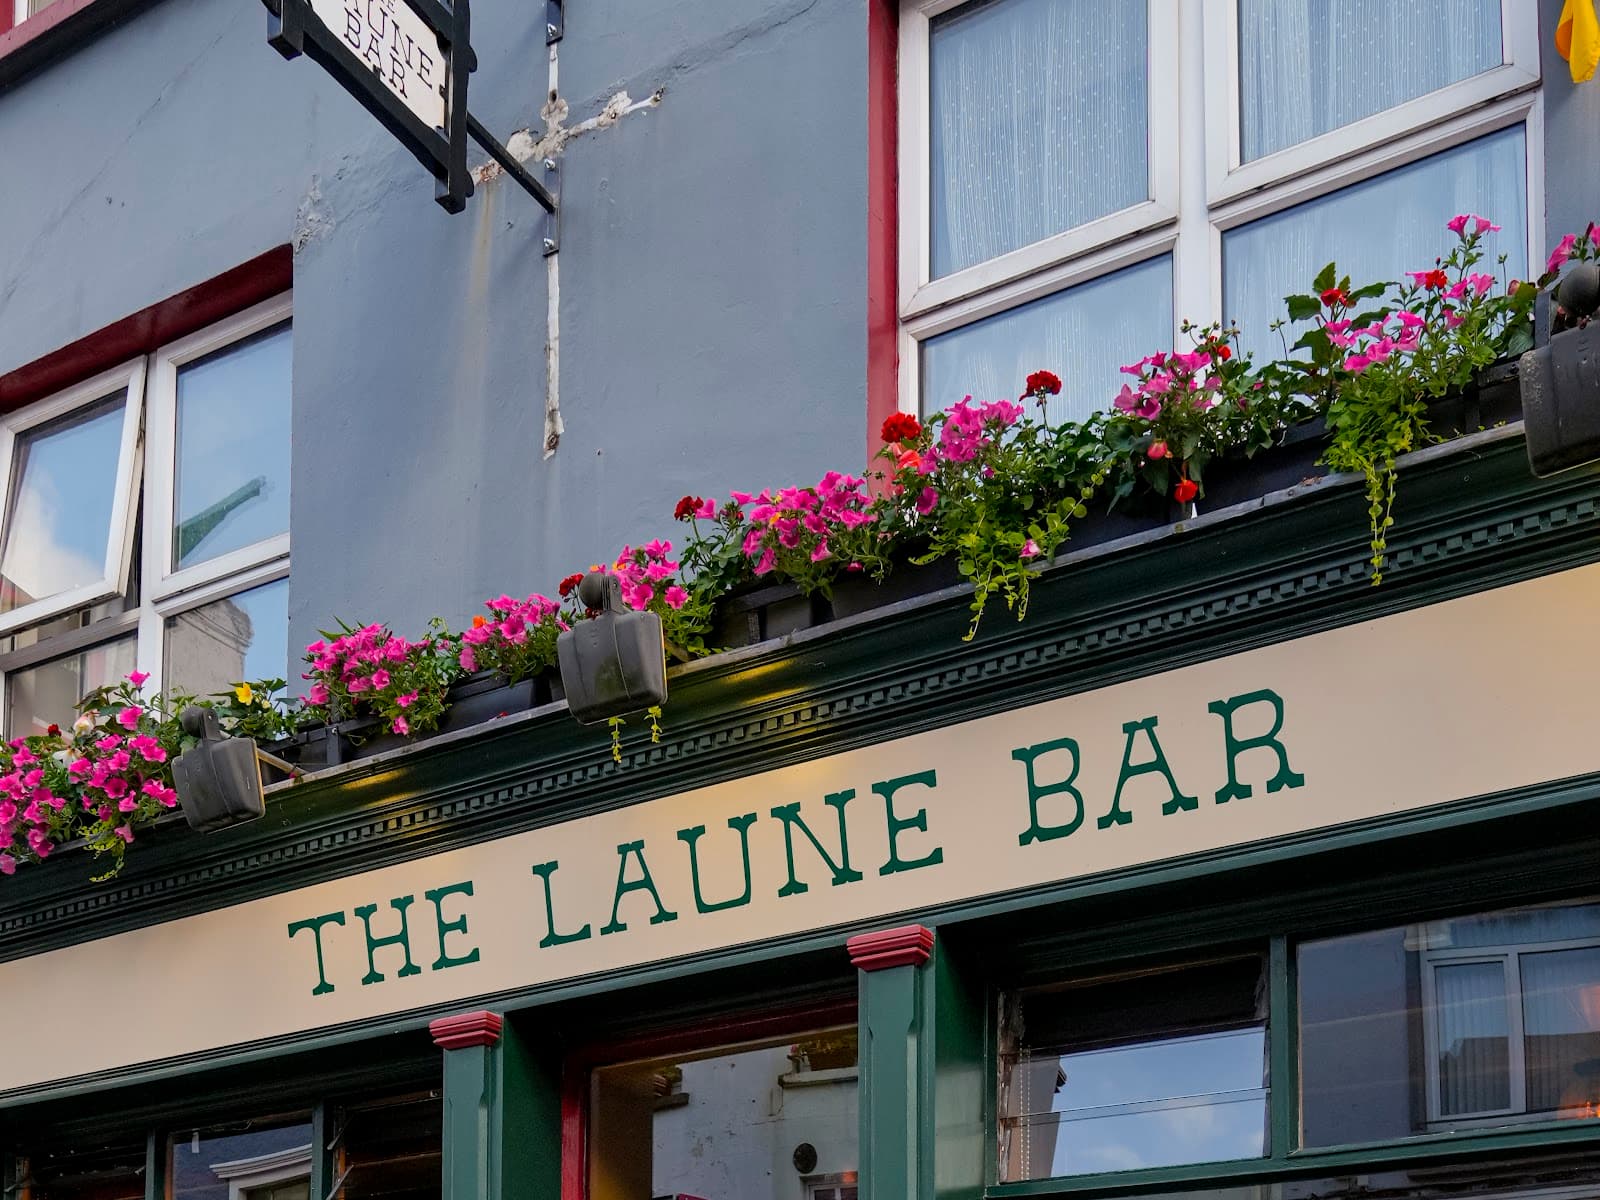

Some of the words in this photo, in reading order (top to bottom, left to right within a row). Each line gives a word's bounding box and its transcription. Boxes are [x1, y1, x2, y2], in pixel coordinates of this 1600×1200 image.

[343, 0, 433, 90] UNE
[343, 7, 408, 99] BAR
[288, 880, 480, 996] THE
[532, 769, 944, 949] LAUNE
[1011, 688, 1305, 846] BAR
